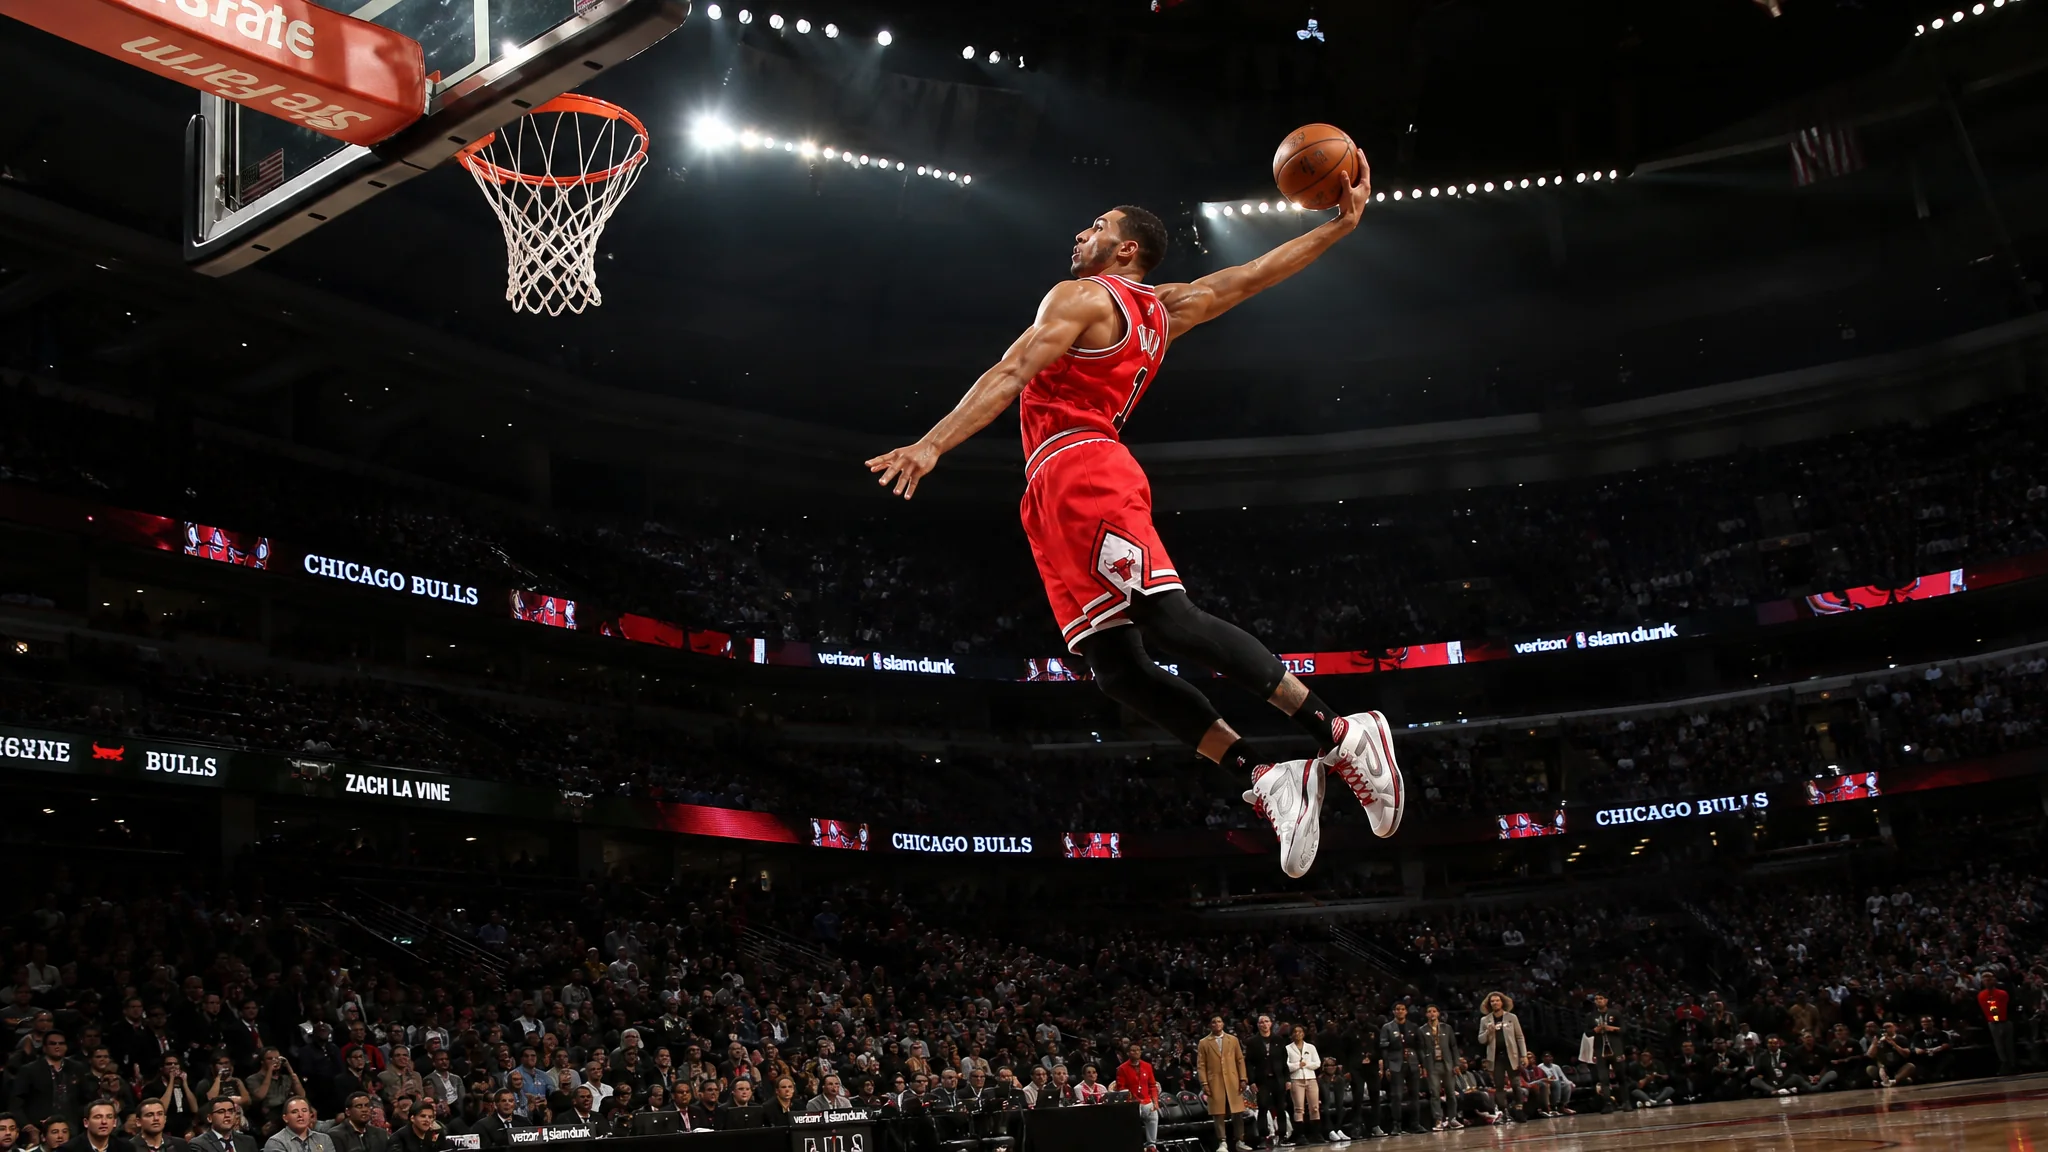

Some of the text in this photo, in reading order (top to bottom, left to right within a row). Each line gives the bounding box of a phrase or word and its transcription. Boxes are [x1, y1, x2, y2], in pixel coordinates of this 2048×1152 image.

[120, 36, 286, 100] Farm
[304, 554, 479, 606] CHICAGO BULLS
[1514, 622, 1678, 654] verizon slam dunk
[817, 650, 956, 675] verizon slam dunk
[145, 750, 217, 777] BULLS
[345, 773, 451, 802] ZACH LA VINE
[1595, 792, 1769, 826] CHICAGO BULLS
[892, 832, 1033, 853] CHICAGO BULLS
